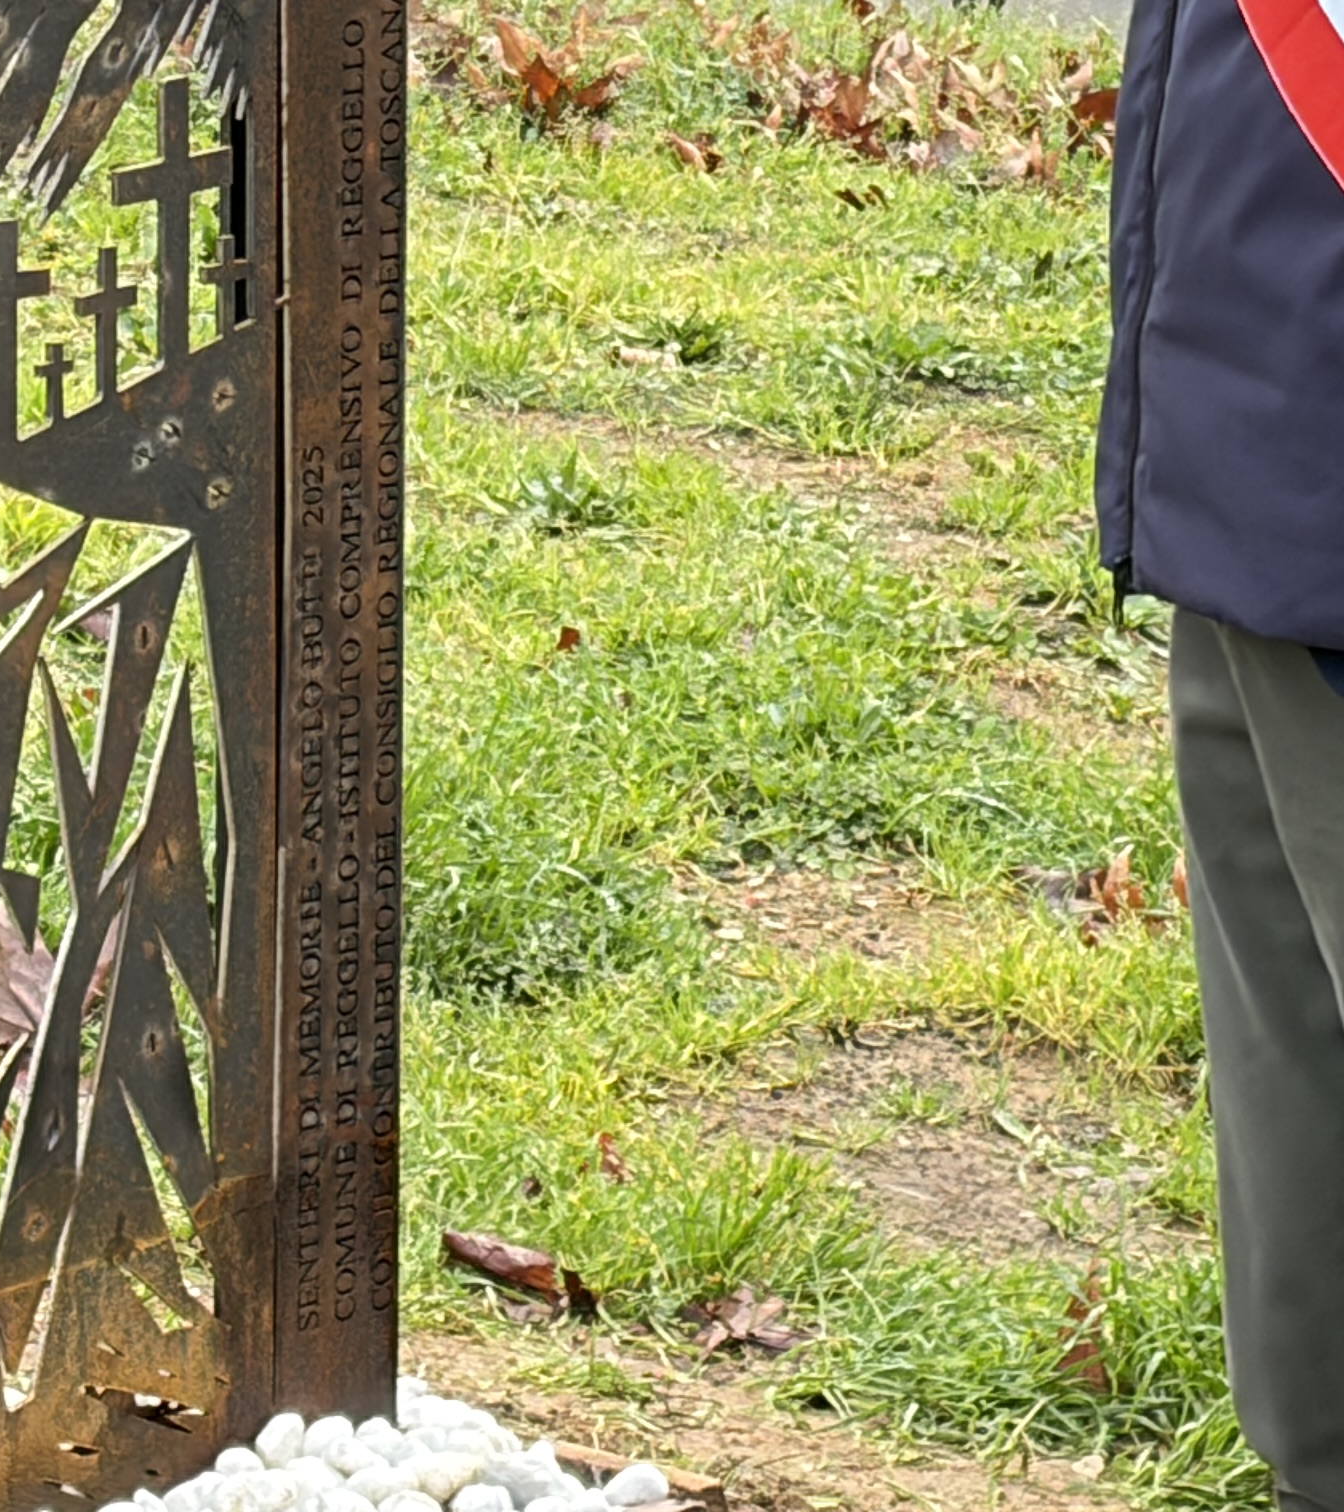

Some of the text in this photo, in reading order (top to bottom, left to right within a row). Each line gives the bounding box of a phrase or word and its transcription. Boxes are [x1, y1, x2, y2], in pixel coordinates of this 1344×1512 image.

[341, 19, 364, 239] REGGELLO
[341, 264, 363, 302] DI
[378, 188, 401, 314] DELLA
[302, 446, 324, 526] 2025
[340, 326, 362, 618] COMPRENSIVO
[377, 339, 400, 574] REGIONALE
[300, 681, 323, 844] ANGELO
[338, 638, 360, 819] ISTITUTO
[376, 592, 398, 806] CONSIGLIO
[375, 817, 396, 892] DEL
[298, 880, 322, 1078] MEMORIE
[336, 854, 360, 1071] REGGELLO
[372, 906, 396, 1166] CONTRIBUTO
[298, 1093, 320, 1132] DI
[336, 1083, 358, 1126] DI
[297, 1148, 320, 1331] SENTIERI
[334, 1142, 357, 1321] COMUNE
[370, 1232, 394, 1311] CON
